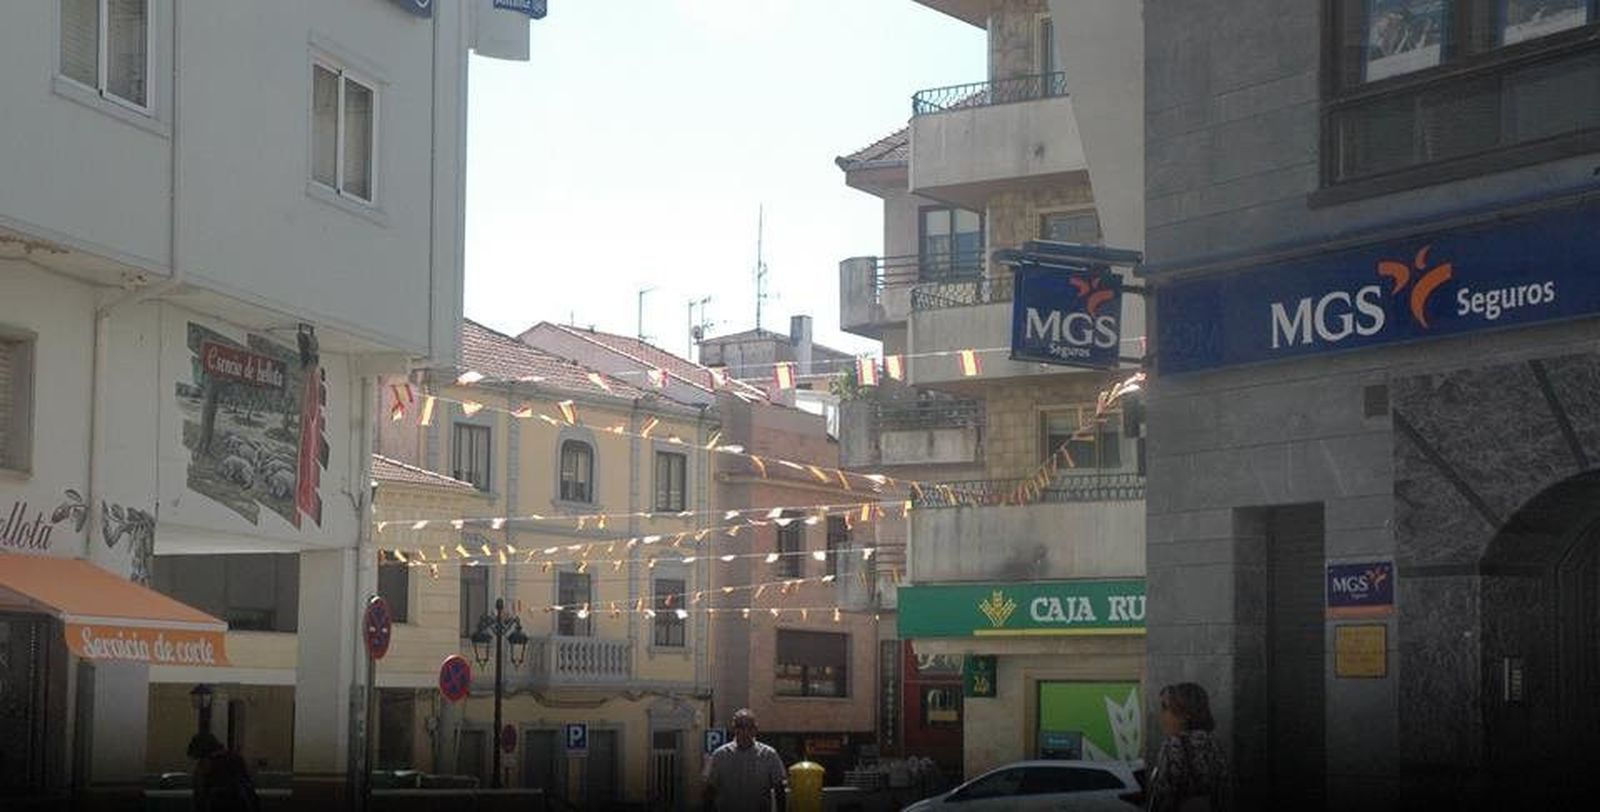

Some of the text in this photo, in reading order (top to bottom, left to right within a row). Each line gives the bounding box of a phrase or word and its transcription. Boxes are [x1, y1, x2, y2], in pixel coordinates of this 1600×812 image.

[1025, 307, 1119, 348] MGS
[1270, 285, 1386, 348] MGS
[1457, 280, 1555, 320] Seguros
[1050, 345, 1090, 358] Seguros
[243, 356, 255, 379] de
[257, 358, 284, 388] bellota
[1332, 574, 1369, 594] MGS
[1030, 594, 1147, 623] CAJA RU
[82, 626, 215, 664] Servicio de corte
[569, 726, 583, 746] P
[707, 731, 721, 753] P
